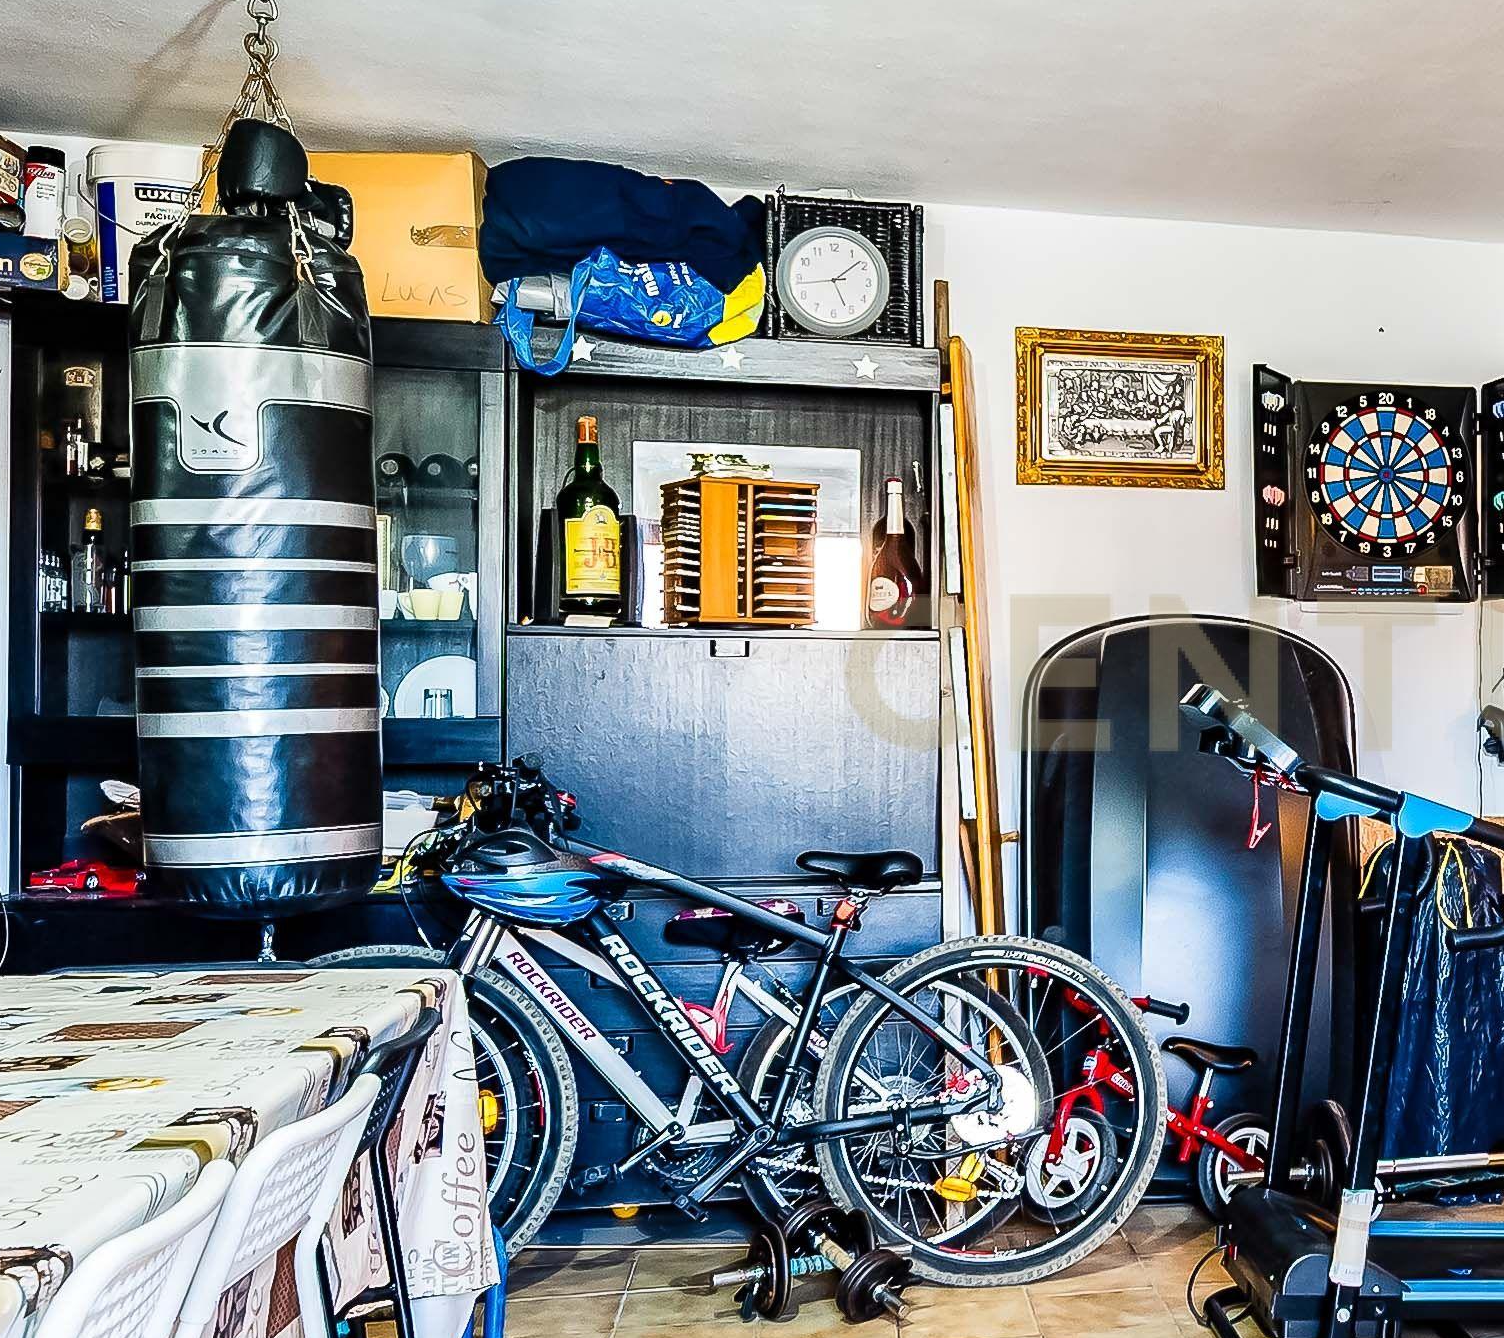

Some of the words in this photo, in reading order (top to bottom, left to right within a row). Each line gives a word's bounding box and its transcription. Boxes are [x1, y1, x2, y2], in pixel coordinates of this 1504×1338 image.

[813, 247, 822, 256] 11
[829, 243, 839, 252] 12
[850, 249, 854, 258] 1
[800, 257, 810, 267] 10
[861, 262, 868, 271] 2
[865, 278, 872, 288] 3
[382, 272, 468, 307] LUCAS
[800, 290, 807, 300] 8
[860, 294, 866, 303] 4
[814, 303, 820, 312] 7
[849, 305, 854, 315] 5
[831, 309, 837, 318] 6
[1359, 396, 1368, 408] 5
[1378, 393, 1394, 405] 20
[1407, 397, 1412, 408] 1
[1336, 406, 1348, 418] 12
[1424, 408, 1436, 420] 18
[1321, 422, 1330, 434] 9
[1442, 426, 1450, 437] 4
[1309, 443, 1321, 455] 14
[1451, 447, 1463, 458] 13
[1307, 468, 1317, 479] 11
[1456, 471, 1464, 482] 6
[1311, 491, 1320, 503] 8
[1451, 495, 1463, 506] 10
[1321, 513, 1333, 525] 16
[1442, 516, 1453, 527] 15
[1339, 530, 1348, 542] 7
[1426, 532, 1435, 543] 2
[1358, 542, 1371, 553] 19
[1382, 546, 1391, 557] 3
[1404, 542, 1417, 554] 17
[506, 950, 598, 1042] ROCKRIDER
[599, 934, 742, 1097] ROCKRIDER
[432, 1131, 482, 1278] Coffee
